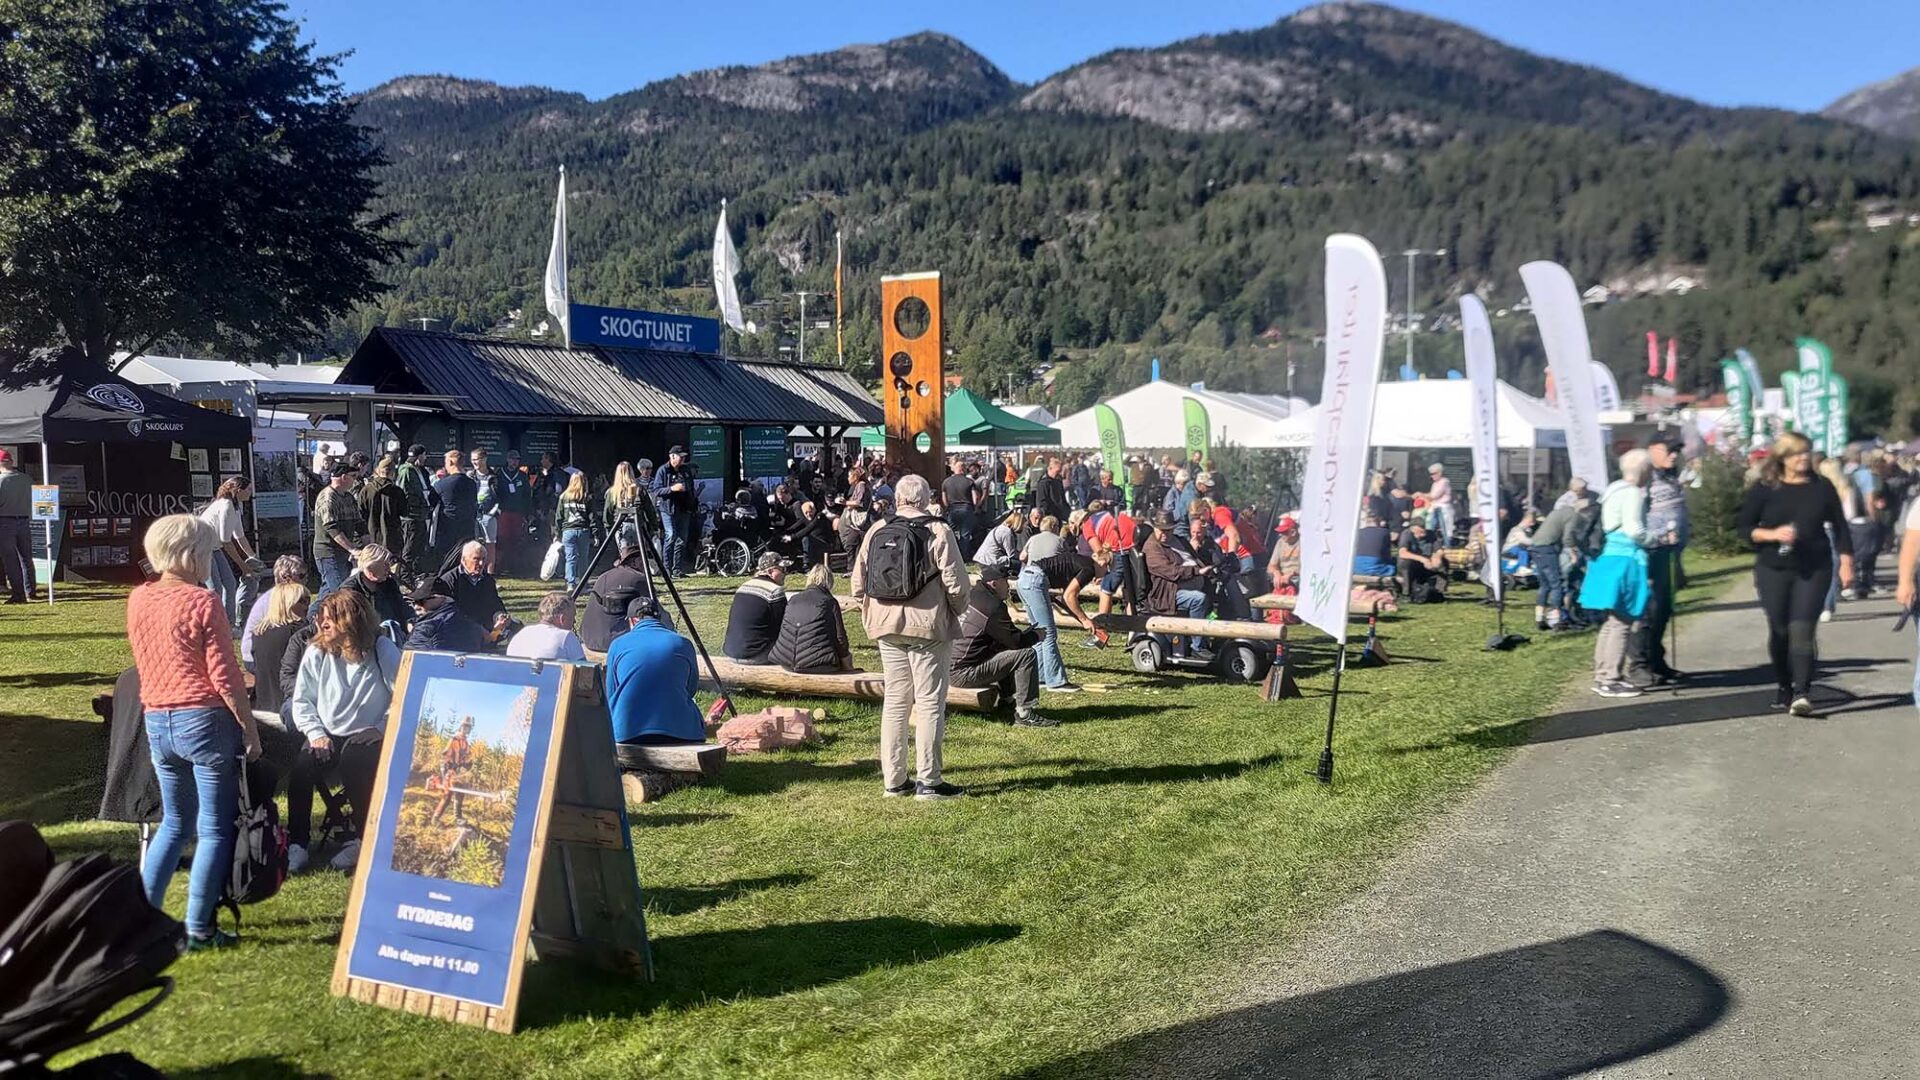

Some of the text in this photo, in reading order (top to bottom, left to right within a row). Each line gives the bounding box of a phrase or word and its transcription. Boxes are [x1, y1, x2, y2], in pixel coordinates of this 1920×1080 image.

[600, 315, 693, 343] SKOGTUNET
[145, 422, 184, 432] SKOGKURS
[87, 490, 190, 518] SKOGKURS
[397, 904, 475, 932] RYDDESAG
[378, 944, 399, 960] Alle
[400, 949, 433, 967] dager
[447, 958, 480, 975] 11.00
